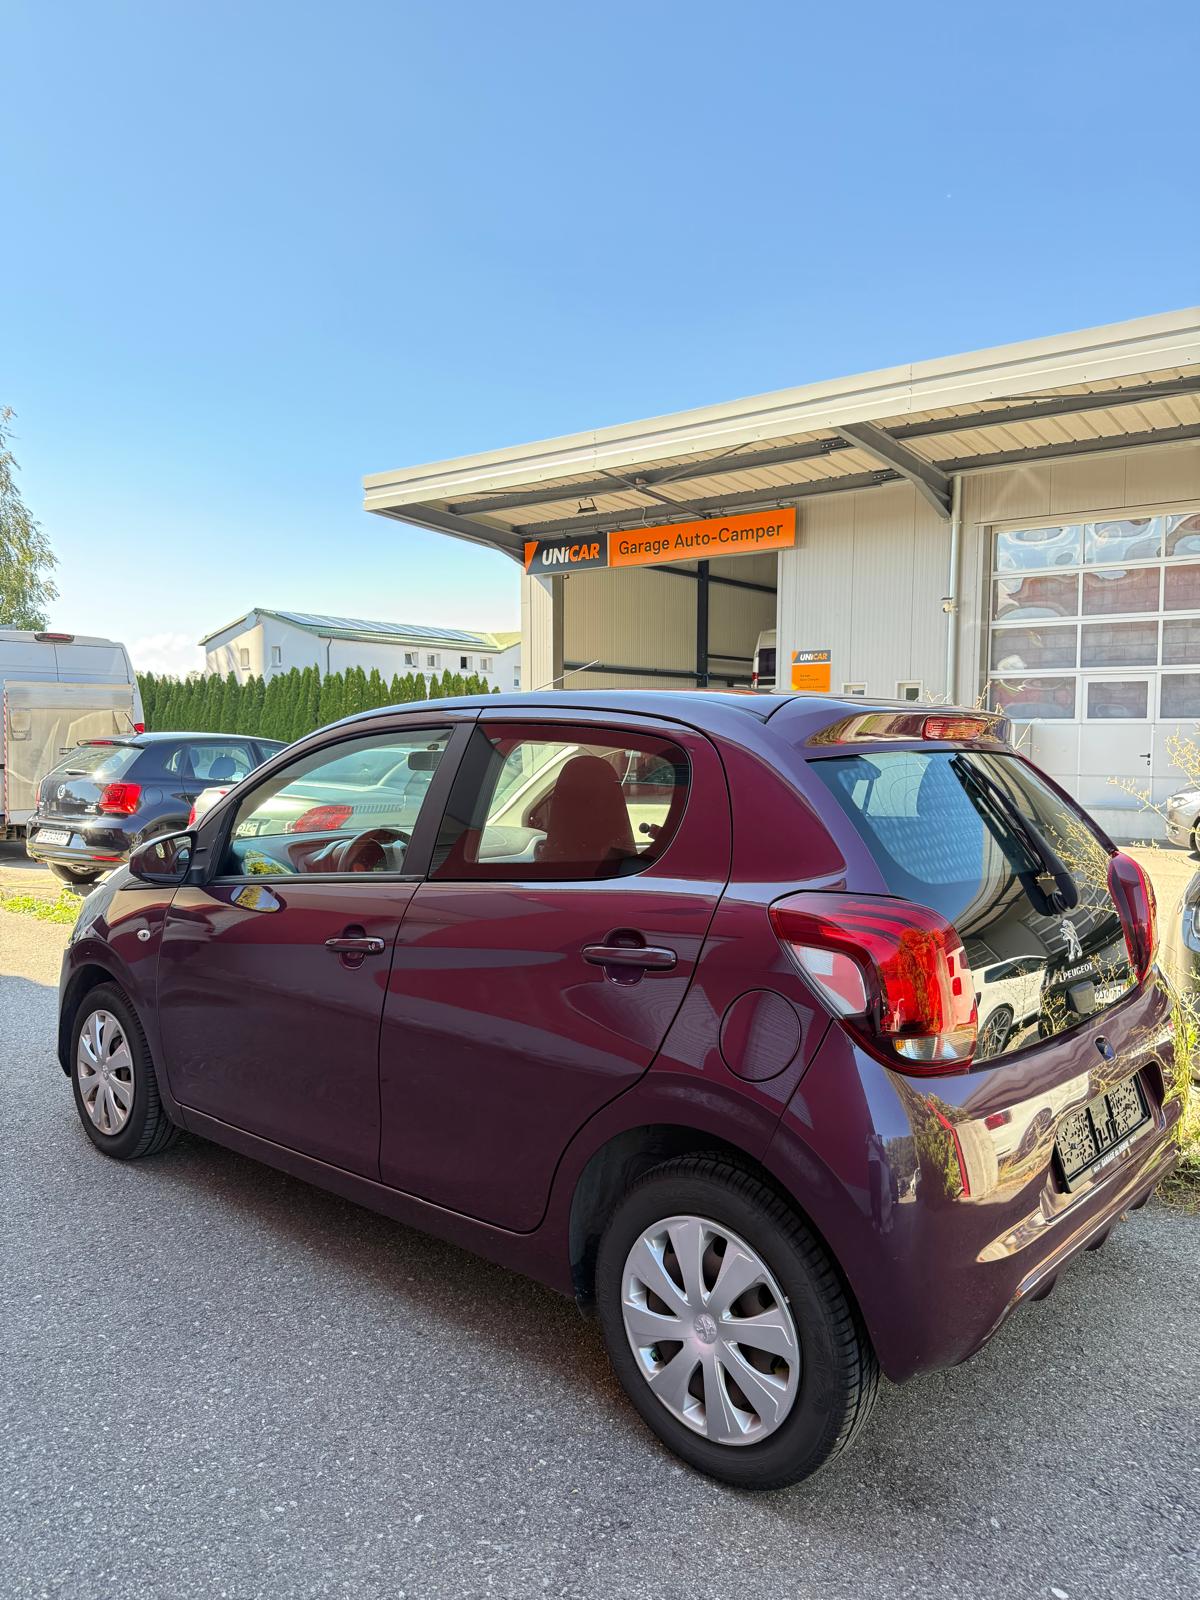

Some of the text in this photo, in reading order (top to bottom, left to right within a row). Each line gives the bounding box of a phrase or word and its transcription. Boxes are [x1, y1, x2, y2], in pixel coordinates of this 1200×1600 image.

[618, 524, 784, 555] Garage Auto-Camper
[1063, 962, 1093, 980] PEUGEOT
